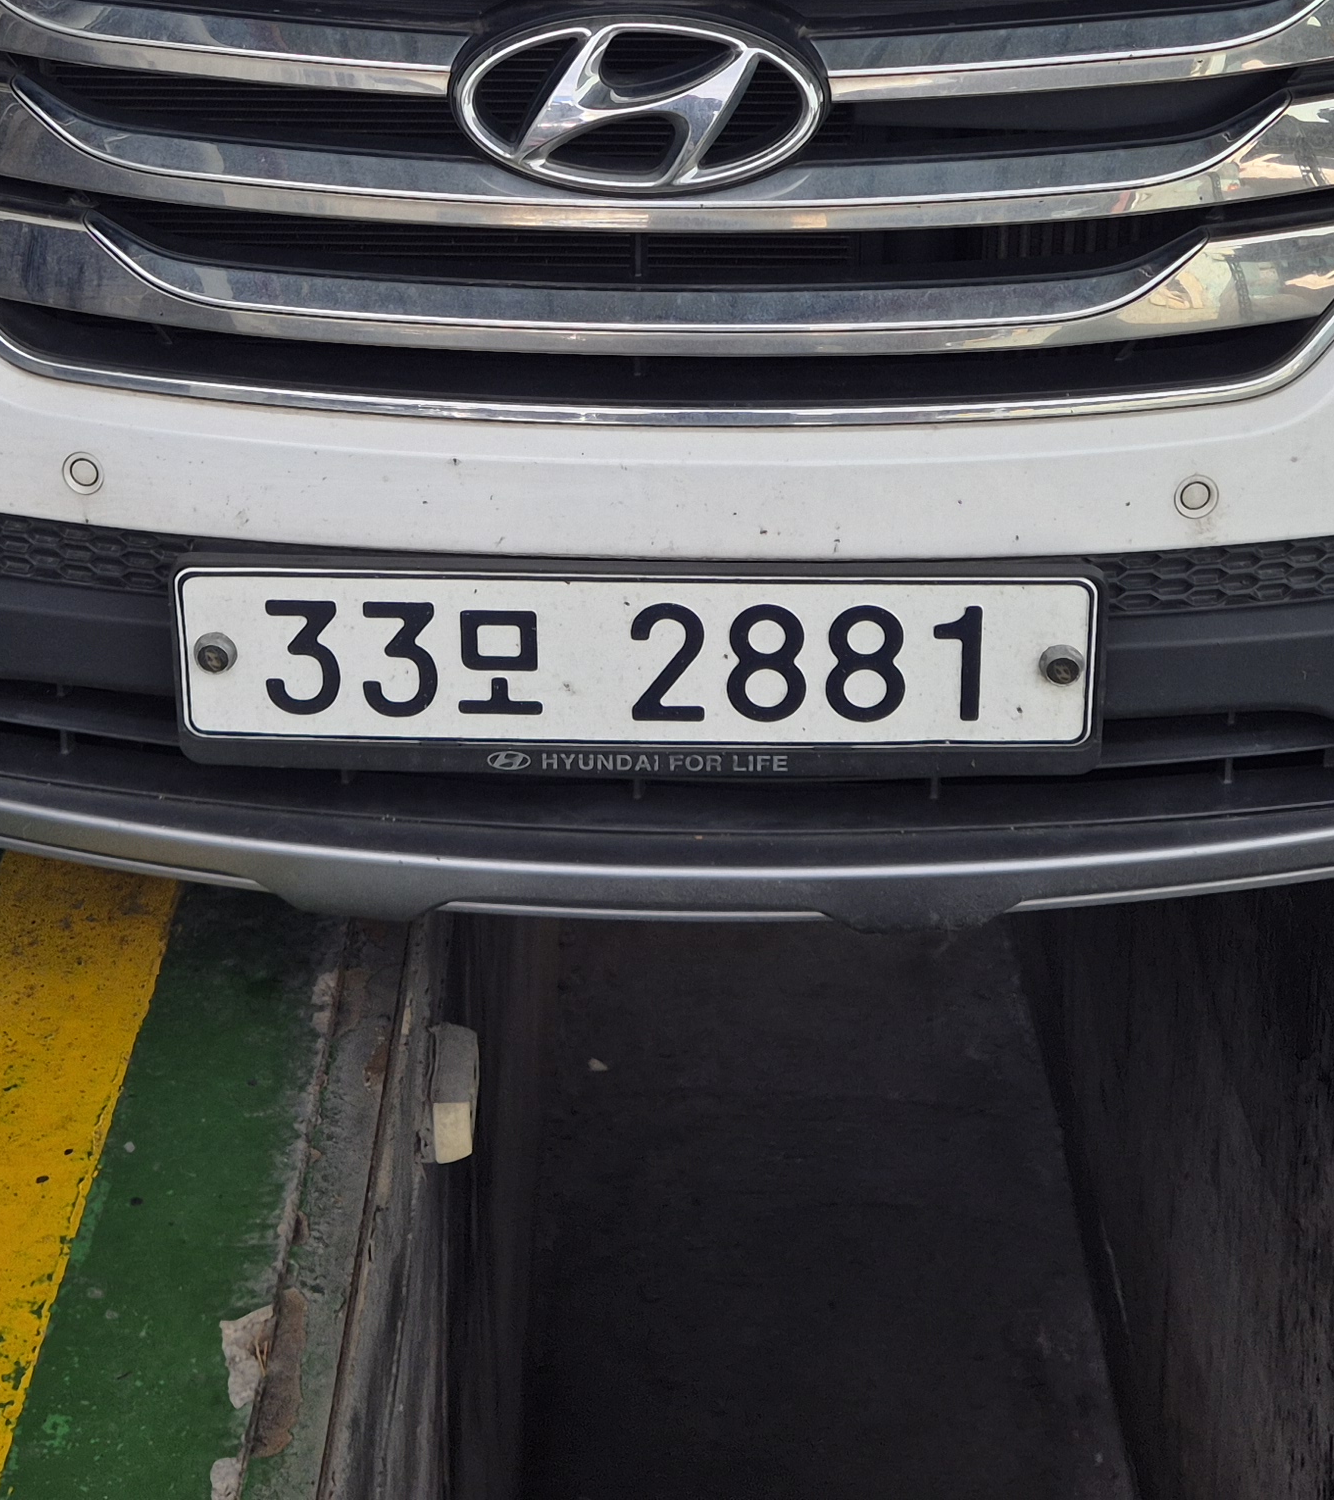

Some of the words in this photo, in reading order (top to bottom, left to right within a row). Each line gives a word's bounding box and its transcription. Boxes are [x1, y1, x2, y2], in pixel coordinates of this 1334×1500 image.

[264, 598, 544, 719] 33모
[630, 601, 984, 723] 2881
[541, 752, 659, 774] HYUNDAI
[669, 753, 730, 774] FOR
[731, 754, 789, 773] LIFE
